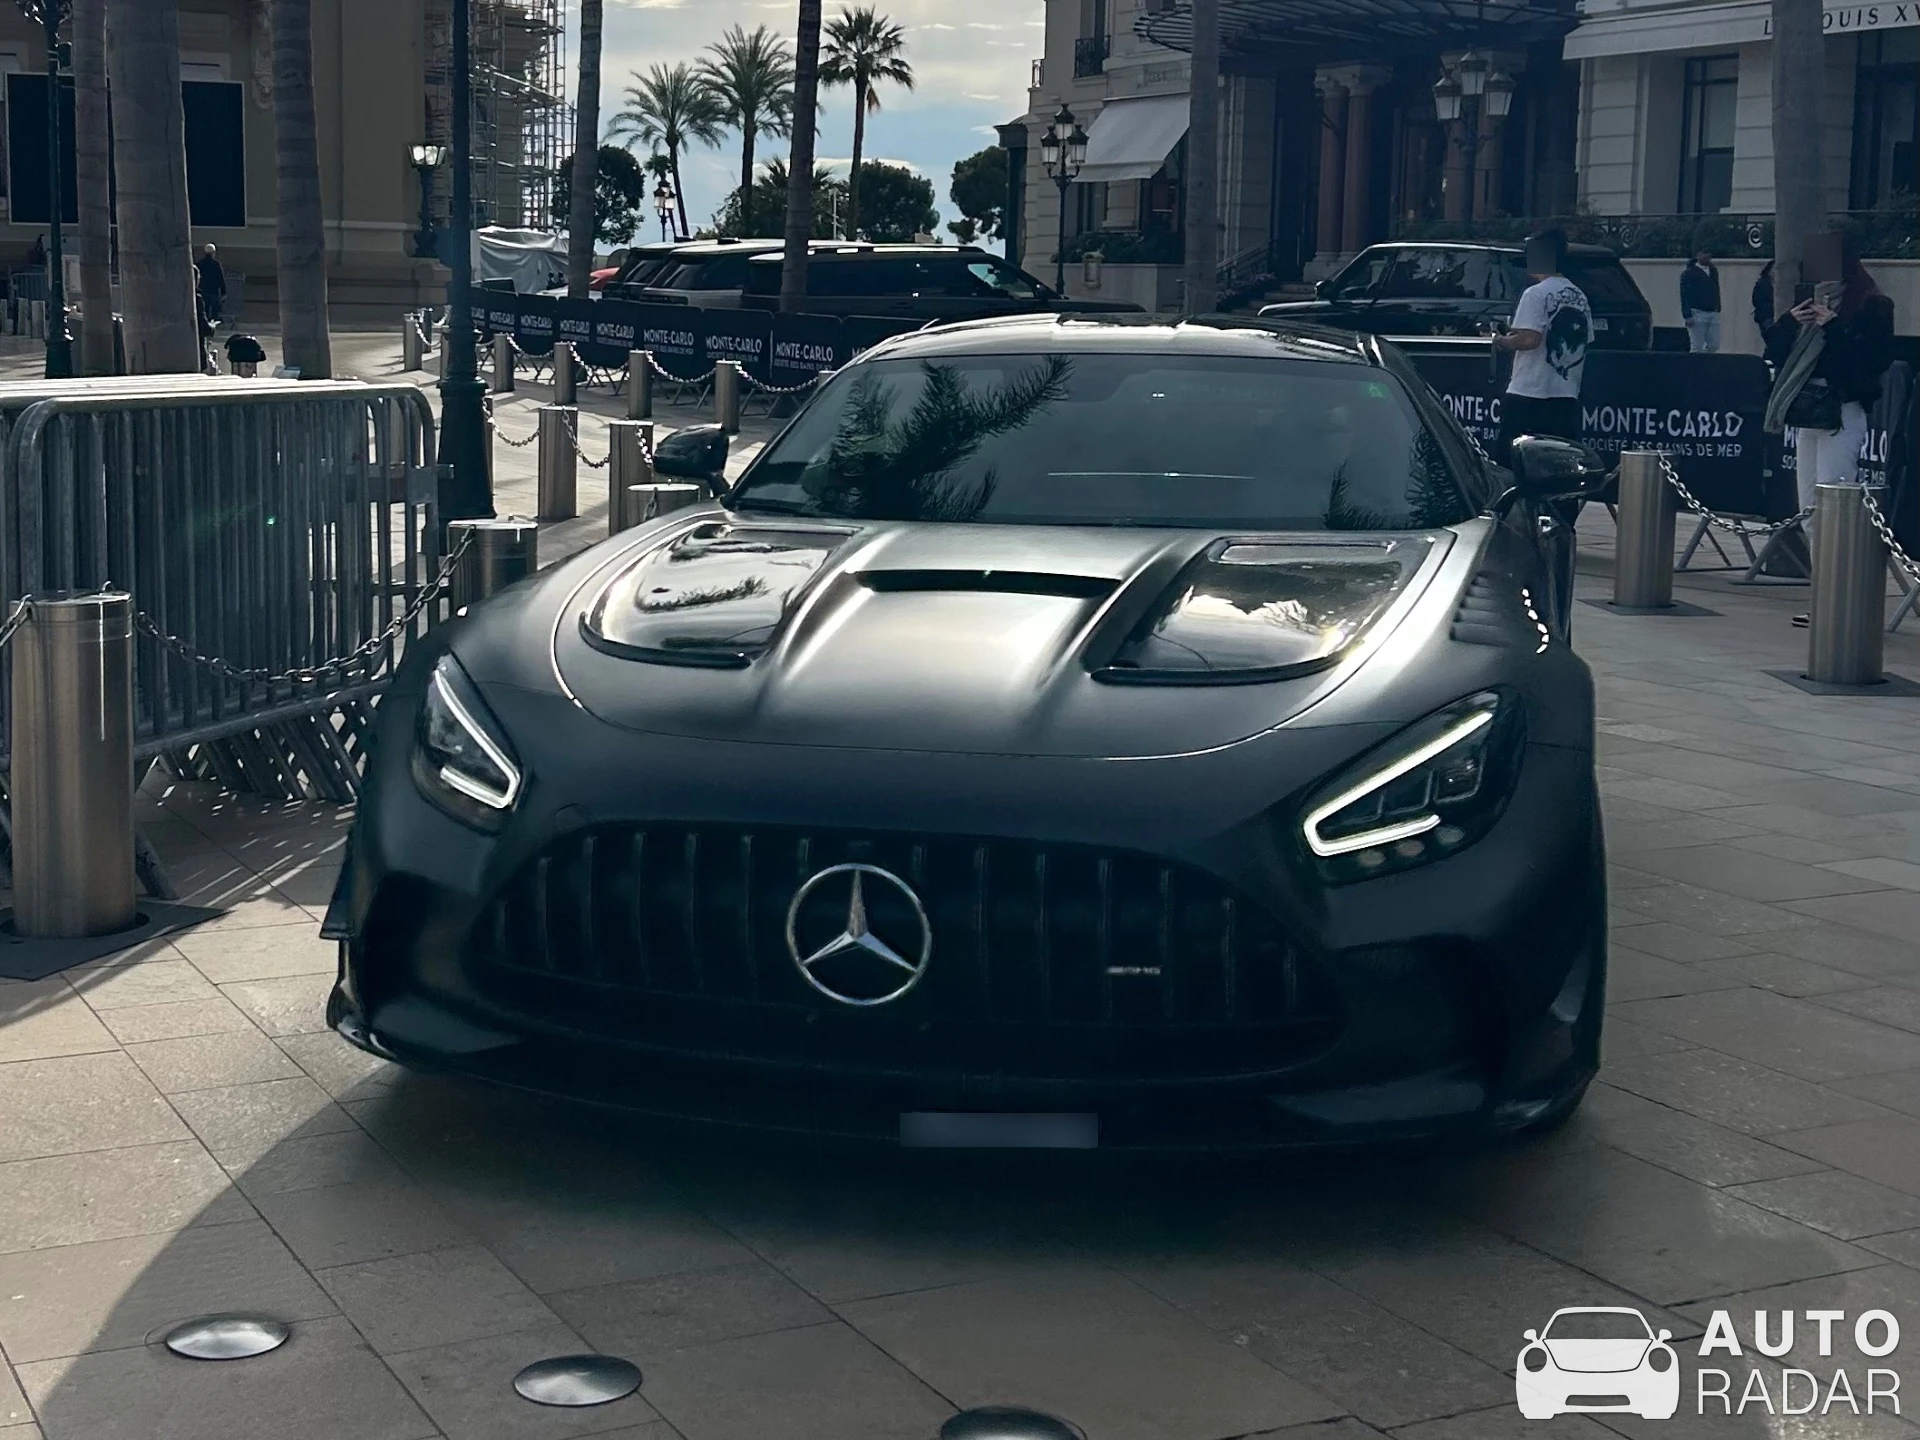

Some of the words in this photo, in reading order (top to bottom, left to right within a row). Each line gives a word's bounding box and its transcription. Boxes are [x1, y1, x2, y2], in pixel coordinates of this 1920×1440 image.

[1823, 7, 1878, 30] OUIS
[1695, 443, 1714, 457] DE
[1716, 443, 1742, 457] MER
